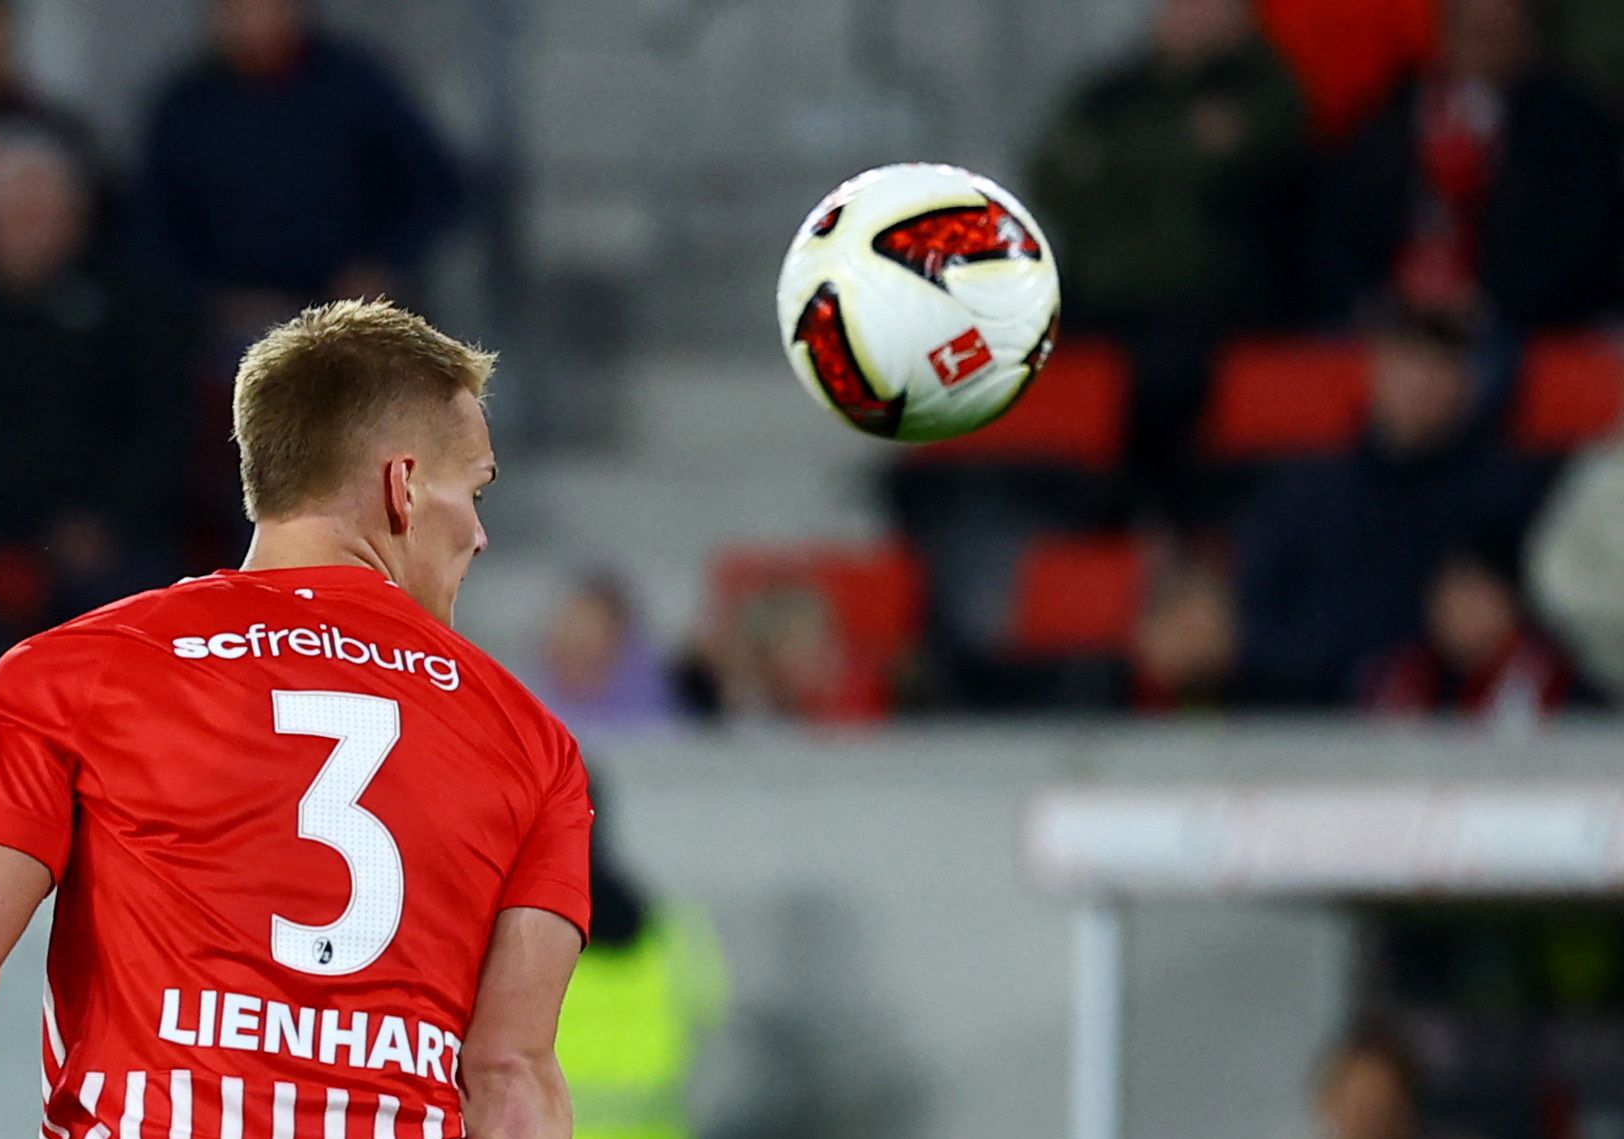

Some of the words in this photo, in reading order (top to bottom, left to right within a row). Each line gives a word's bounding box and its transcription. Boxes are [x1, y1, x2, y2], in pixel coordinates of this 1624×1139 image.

[172, 623, 460, 691] scfreiburg
[271, 689, 405, 976] 3
[158, 988, 462, 1091] LIENHART
